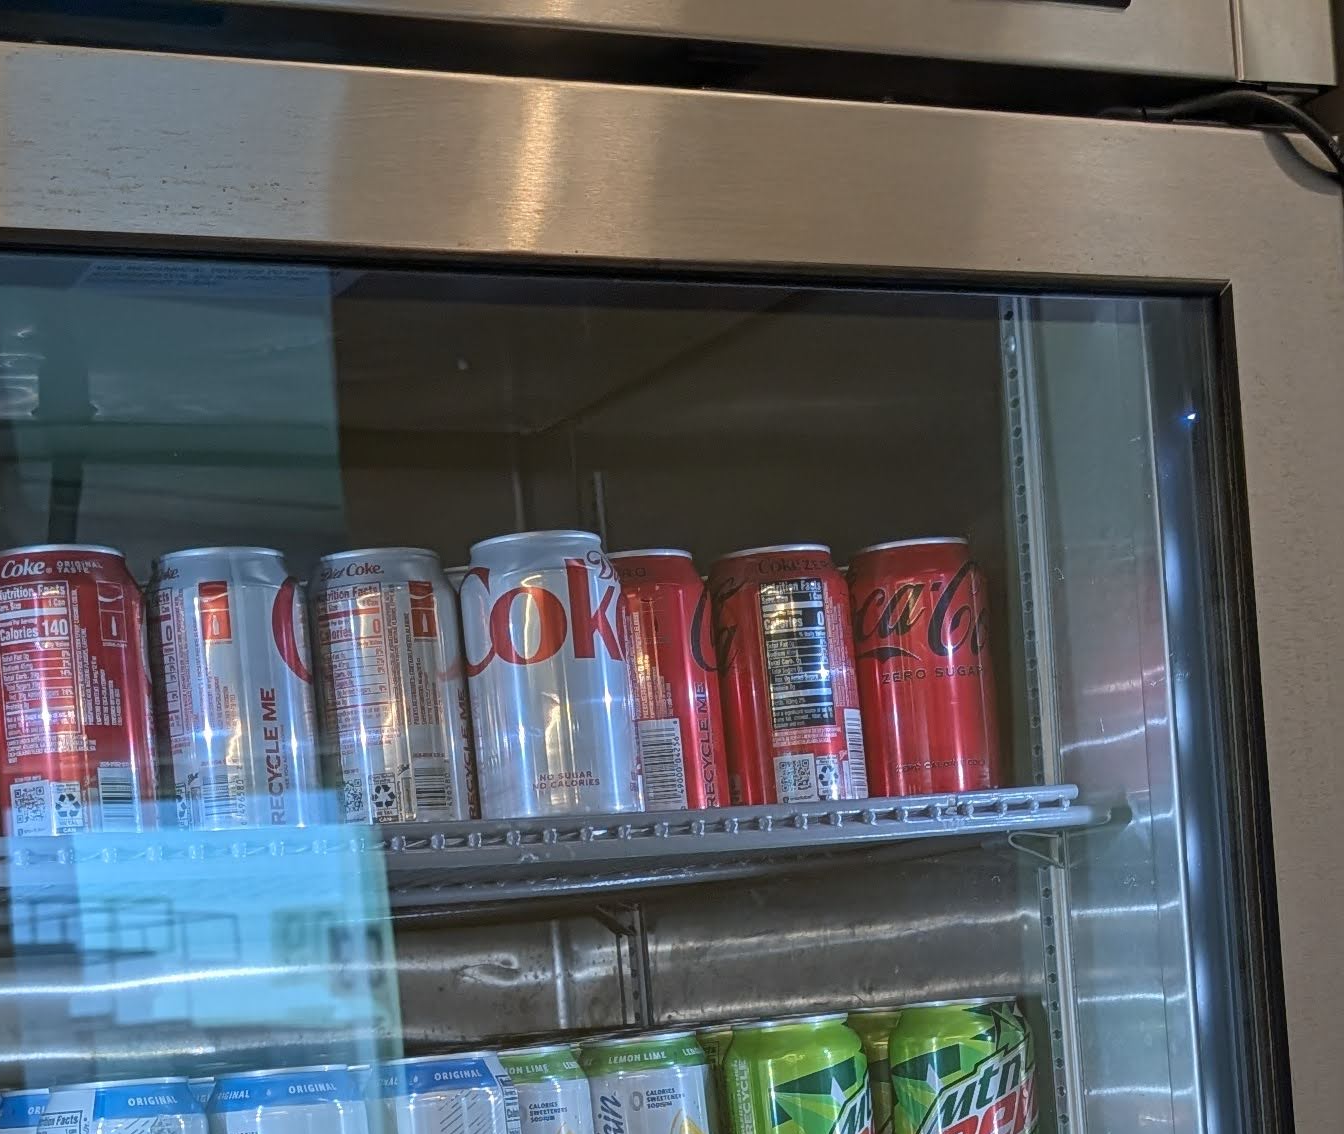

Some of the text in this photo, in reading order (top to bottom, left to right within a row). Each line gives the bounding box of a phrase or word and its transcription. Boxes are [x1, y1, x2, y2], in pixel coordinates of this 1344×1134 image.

[1, 558, 46, 579] Coke
[347, 563, 381, 577] Coke
[801, 580, 822, 591] Facts
[372, 618, 381, 634] 0
[764, 611, 824, 631] Calories 0
[0, 619, 68, 641] Calories 140
[882, 665, 983, 685] ZERO SUGAR
[260, 688, 279, 722] ME
[694, 682, 720, 808] RECYCLE ME
[264, 727, 287, 826] RECYCLE
[558, 771, 592, 780] SUGAR
[533, 778, 600, 791] NO CALORIES
[608, 1051, 667, 1065] LEMON LIME
[526, 1063, 549, 1073] LIME
[434, 1069, 482, 1081] ORIGINAL
[288, 1082, 337, 1094] ORIGINAL
[646, 1088, 675, 1096] CALORIES
[128, 1096, 178, 1107] ORIGINAL
[529, 1102, 558, 1110] CALORIES
[56, 1115, 78, 1126] Facts
[530, 1115, 556, 1123] SODIUM
